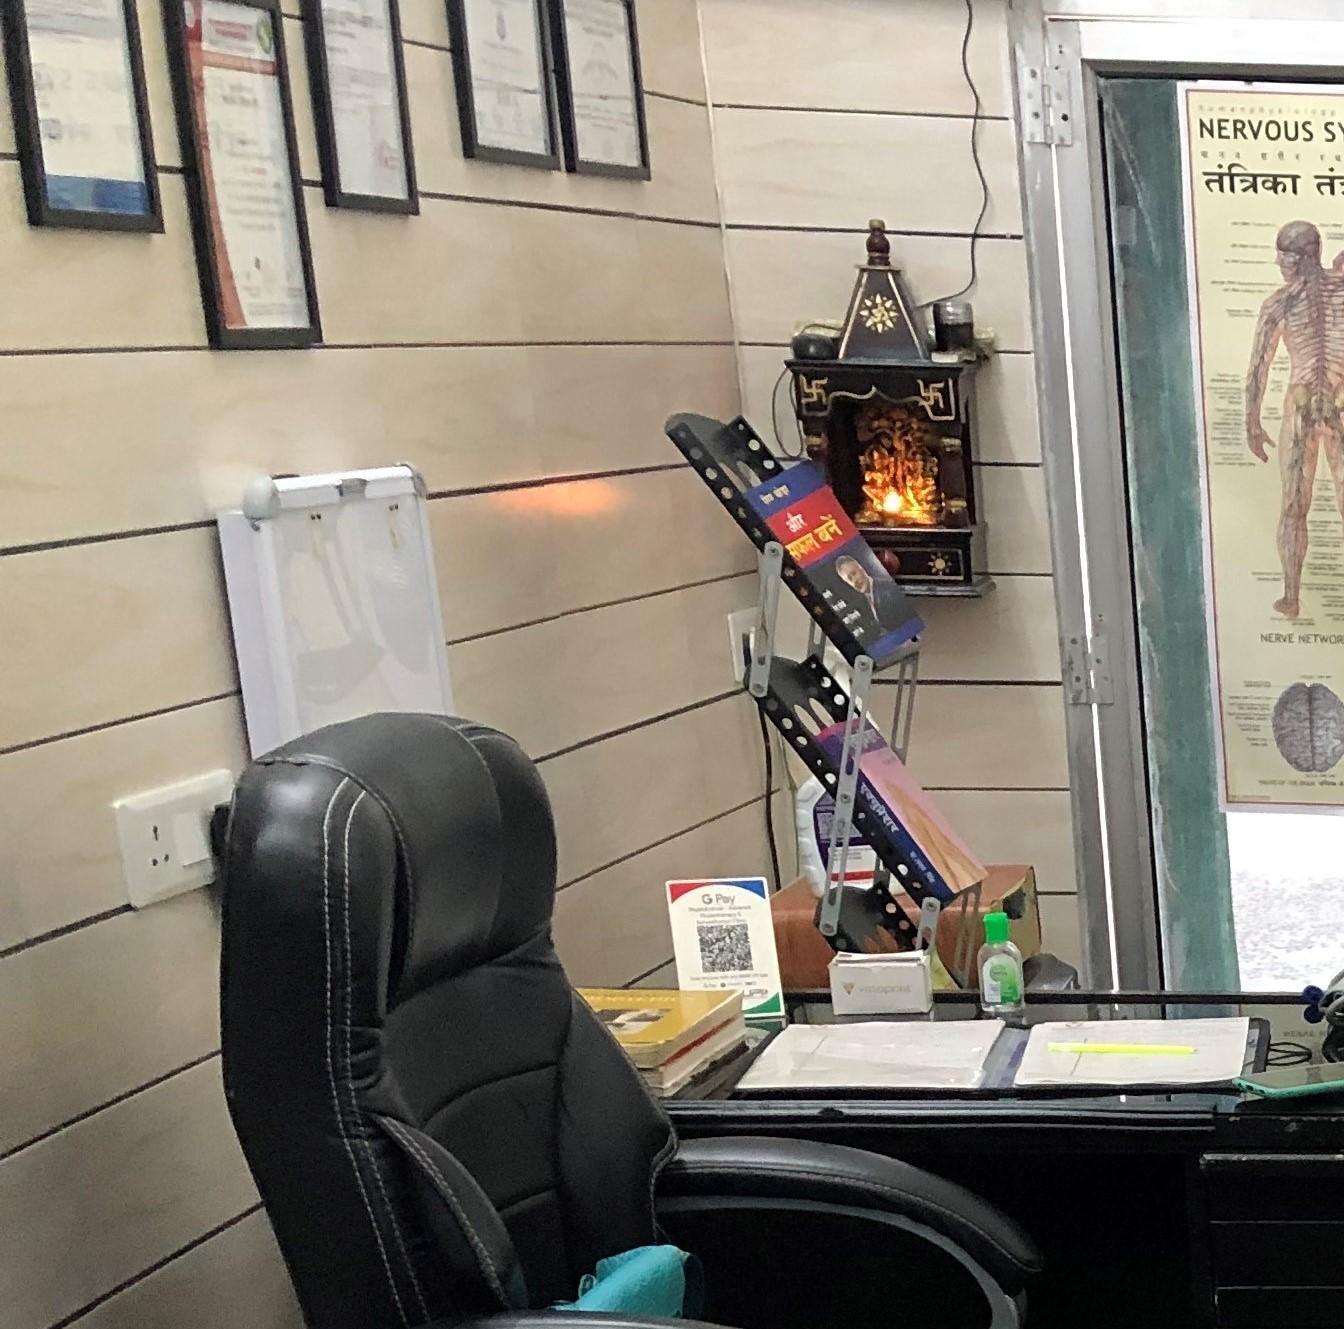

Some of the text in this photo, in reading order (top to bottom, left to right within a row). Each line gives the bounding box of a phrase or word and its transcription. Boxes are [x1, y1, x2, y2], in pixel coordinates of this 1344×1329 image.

[1199, 118, 1314, 142] NERVOUS
[1202, 163, 1302, 195] तंत्रिका
[786, 512, 808, 533] और
[1260, 633, 1294, 644] NERVE
[701, 893, 736, 905] G Pay
